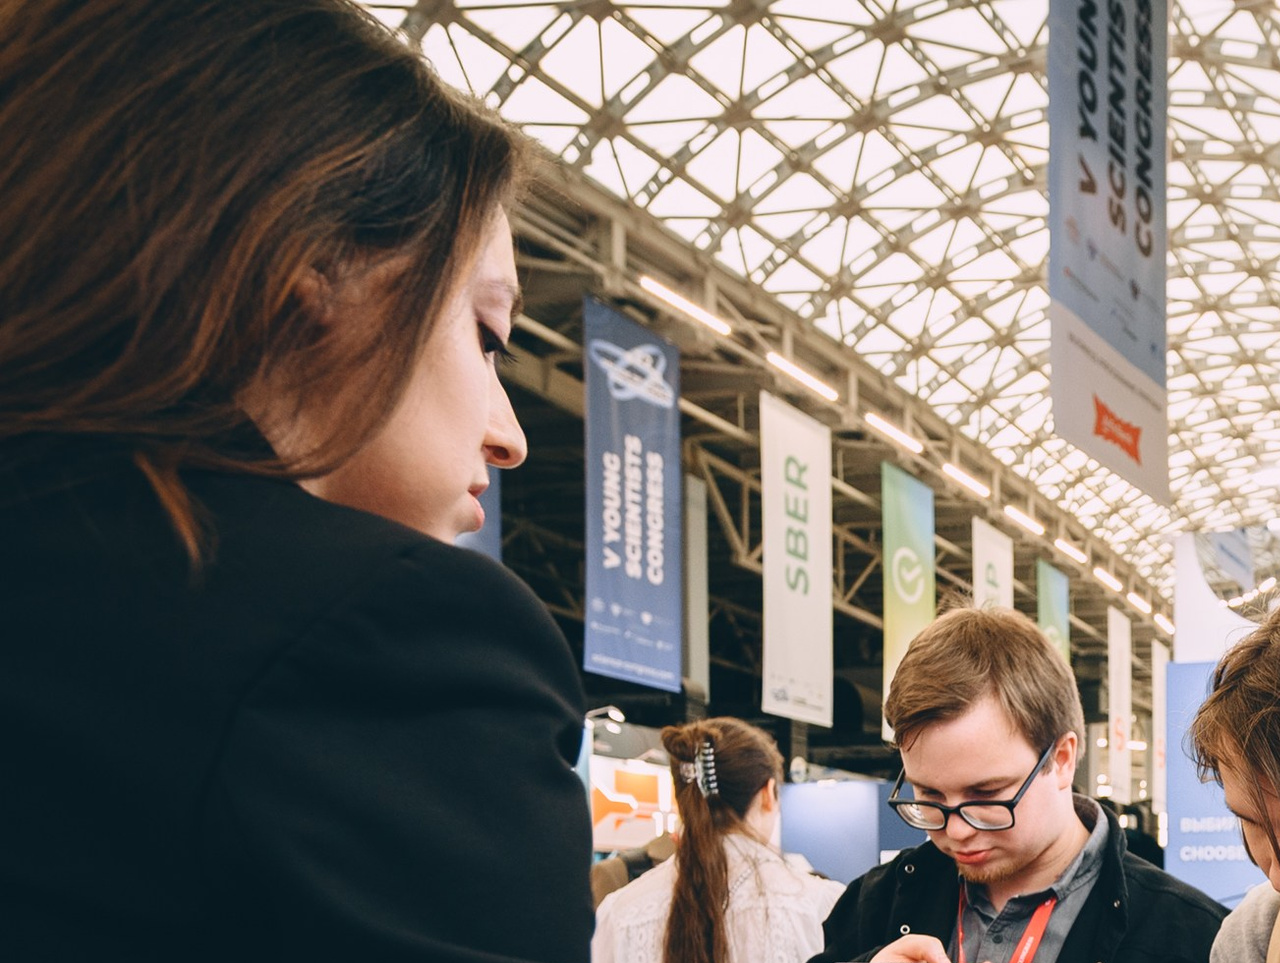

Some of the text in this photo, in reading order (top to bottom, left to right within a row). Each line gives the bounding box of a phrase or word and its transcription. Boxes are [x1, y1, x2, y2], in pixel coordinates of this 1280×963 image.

[1078, 0, 1097, 194] V YOUN
[1107, 0, 1126, 235] SCIENTIS
[603, 451, 621, 569] V YOUNG
[624, 434, 642, 579] SCIENTISTS
[646, 451, 664, 585] CONGRESS
[784, 455, 809, 595] SBER
